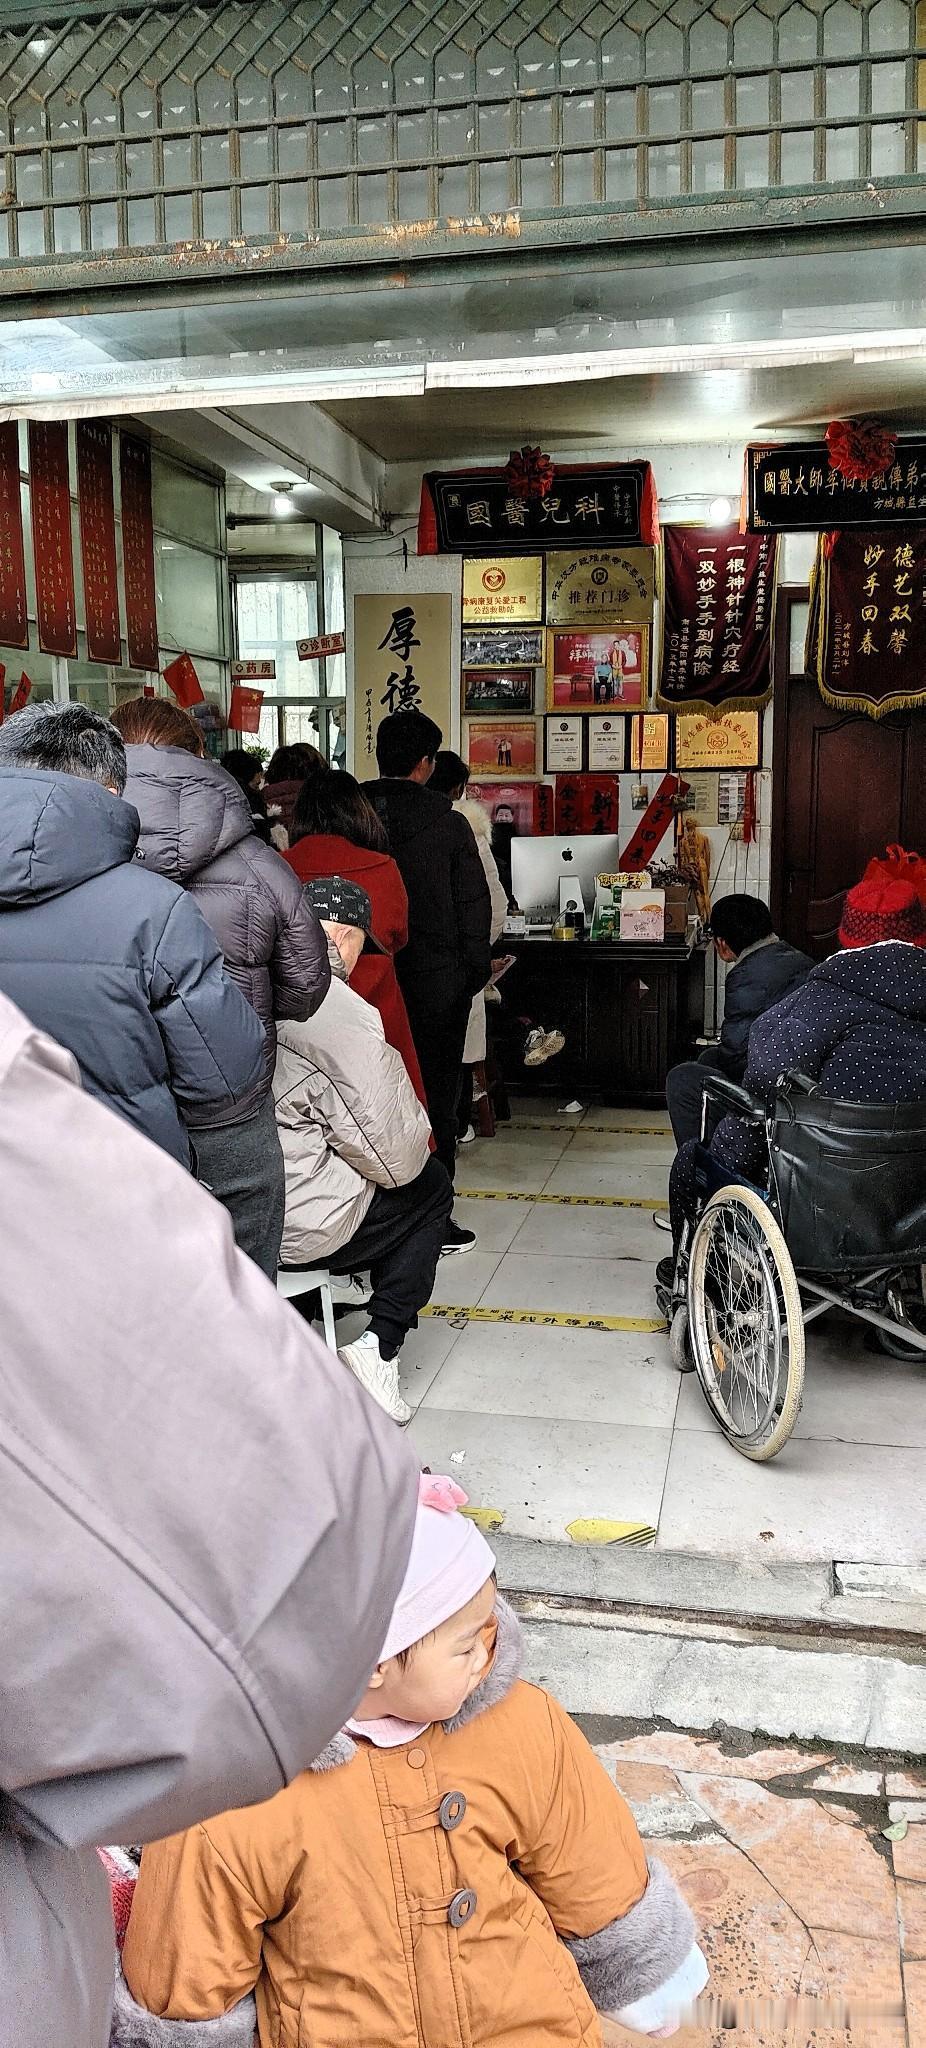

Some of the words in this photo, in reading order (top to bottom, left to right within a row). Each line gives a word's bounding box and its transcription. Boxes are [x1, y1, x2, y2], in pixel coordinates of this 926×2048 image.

[466, 492, 604, 527] 國醫兒科
[474, 605, 515, 615] 公益救助站
[568, 589, 630, 604] 推荐门诊
[693, 547, 718, 677] 一双妙手手到病除
[720, 544, 747, 674] 一根神针针穴疗经
[857, 544, 885, 655] 妙手回春
[887, 544, 915, 655] 德艺双馨
[309, 634, 344, 651] 诊断室
[377, 606, 422, 713] 厚德
[246, 662, 271, 674] 药房
[432, 1309, 605, 1327] 请在一米线外等候
